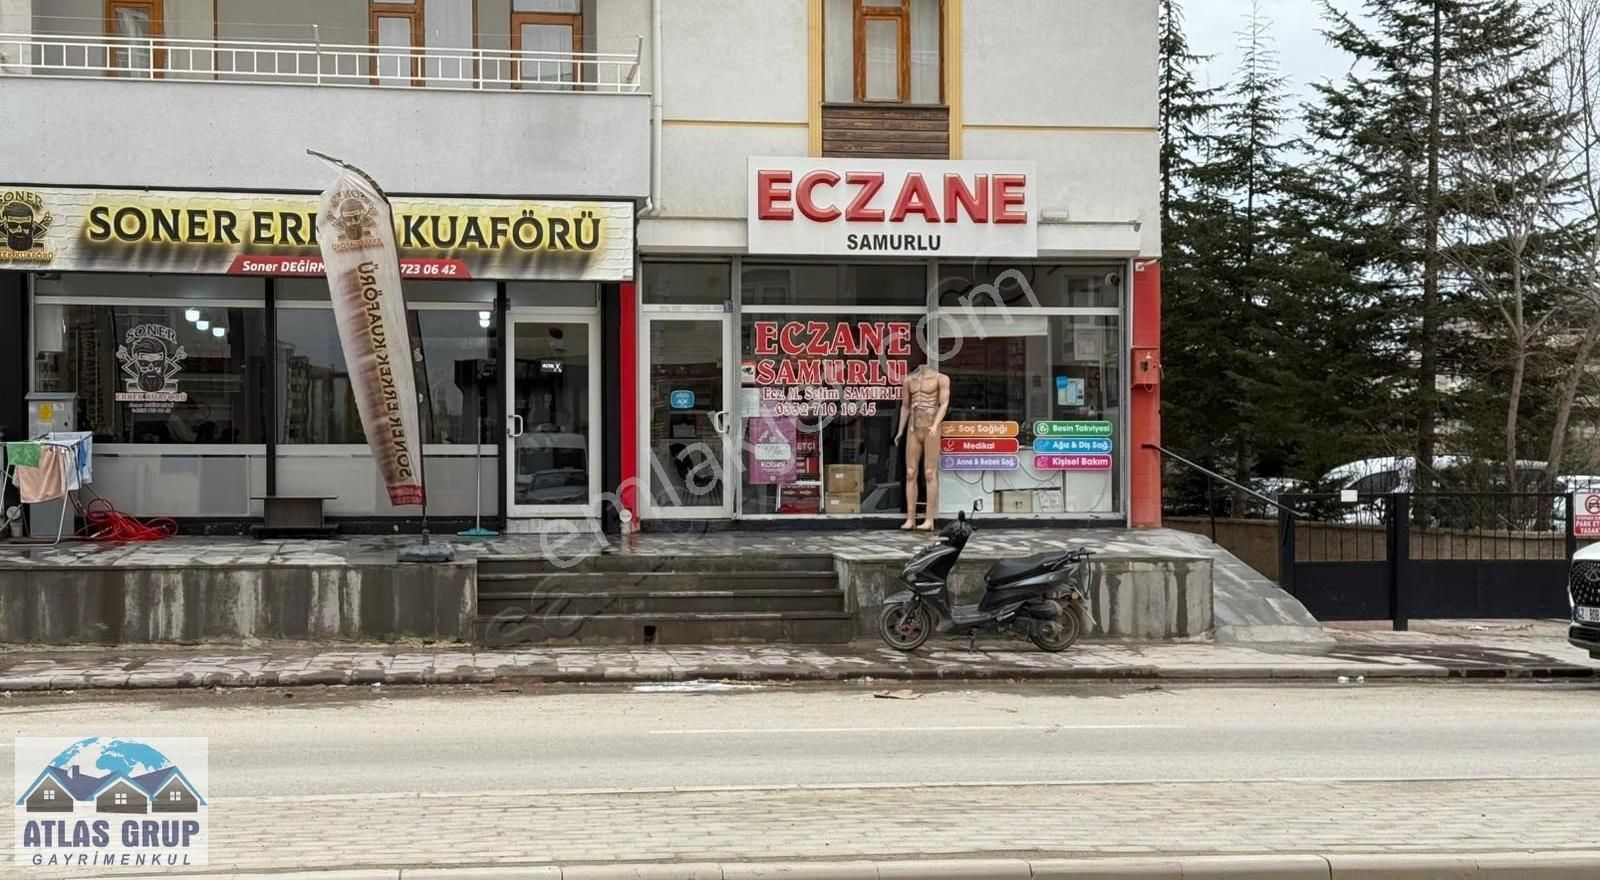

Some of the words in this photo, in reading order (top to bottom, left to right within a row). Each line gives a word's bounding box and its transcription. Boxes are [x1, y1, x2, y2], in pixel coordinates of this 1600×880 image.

[757, 168, 1028, 224] ECZANE
[88, 206, 241, 244] SONER
[401, 208, 601, 251] KUAFÖRÜ
[846, 233, 942, 251] SAMURLU
[242, 260, 278, 273] Soner
[400, 264, 421, 275] 723
[423, 264, 439, 275] 06
[441, 265, 457, 275] 42
[125, 324, 178, 344] SONER
[754, 321, 912, 356] ECZANE
[755, 359, 909, 386] SAMURLU
[762, 387, 785, 400] Ecz.
[788, 387, 803, 400] M.
[775, 402, 809, 417] 0332
[812, 402, 837, 417] 710
[840, 402, 856, 417] 10
[858, 402, 877, 417] 45
[958, 425, 975, 436] Saç
[977, 424, 1008, 436] Sağlığı
[1052, 425, 1074, 433] Besin
[1075, 425, 1111, 434] Takviyesi
[963, 442, 995, 450] Medikal
[1052, 441, 1069, 451] Ağız
[1071, 441, 1077, 449] &
[1079, 441, 1091, 451] Diş
[1052, 458, 1080, 468] Kişisel
[1081, 458, 1109, 466] Bakım
